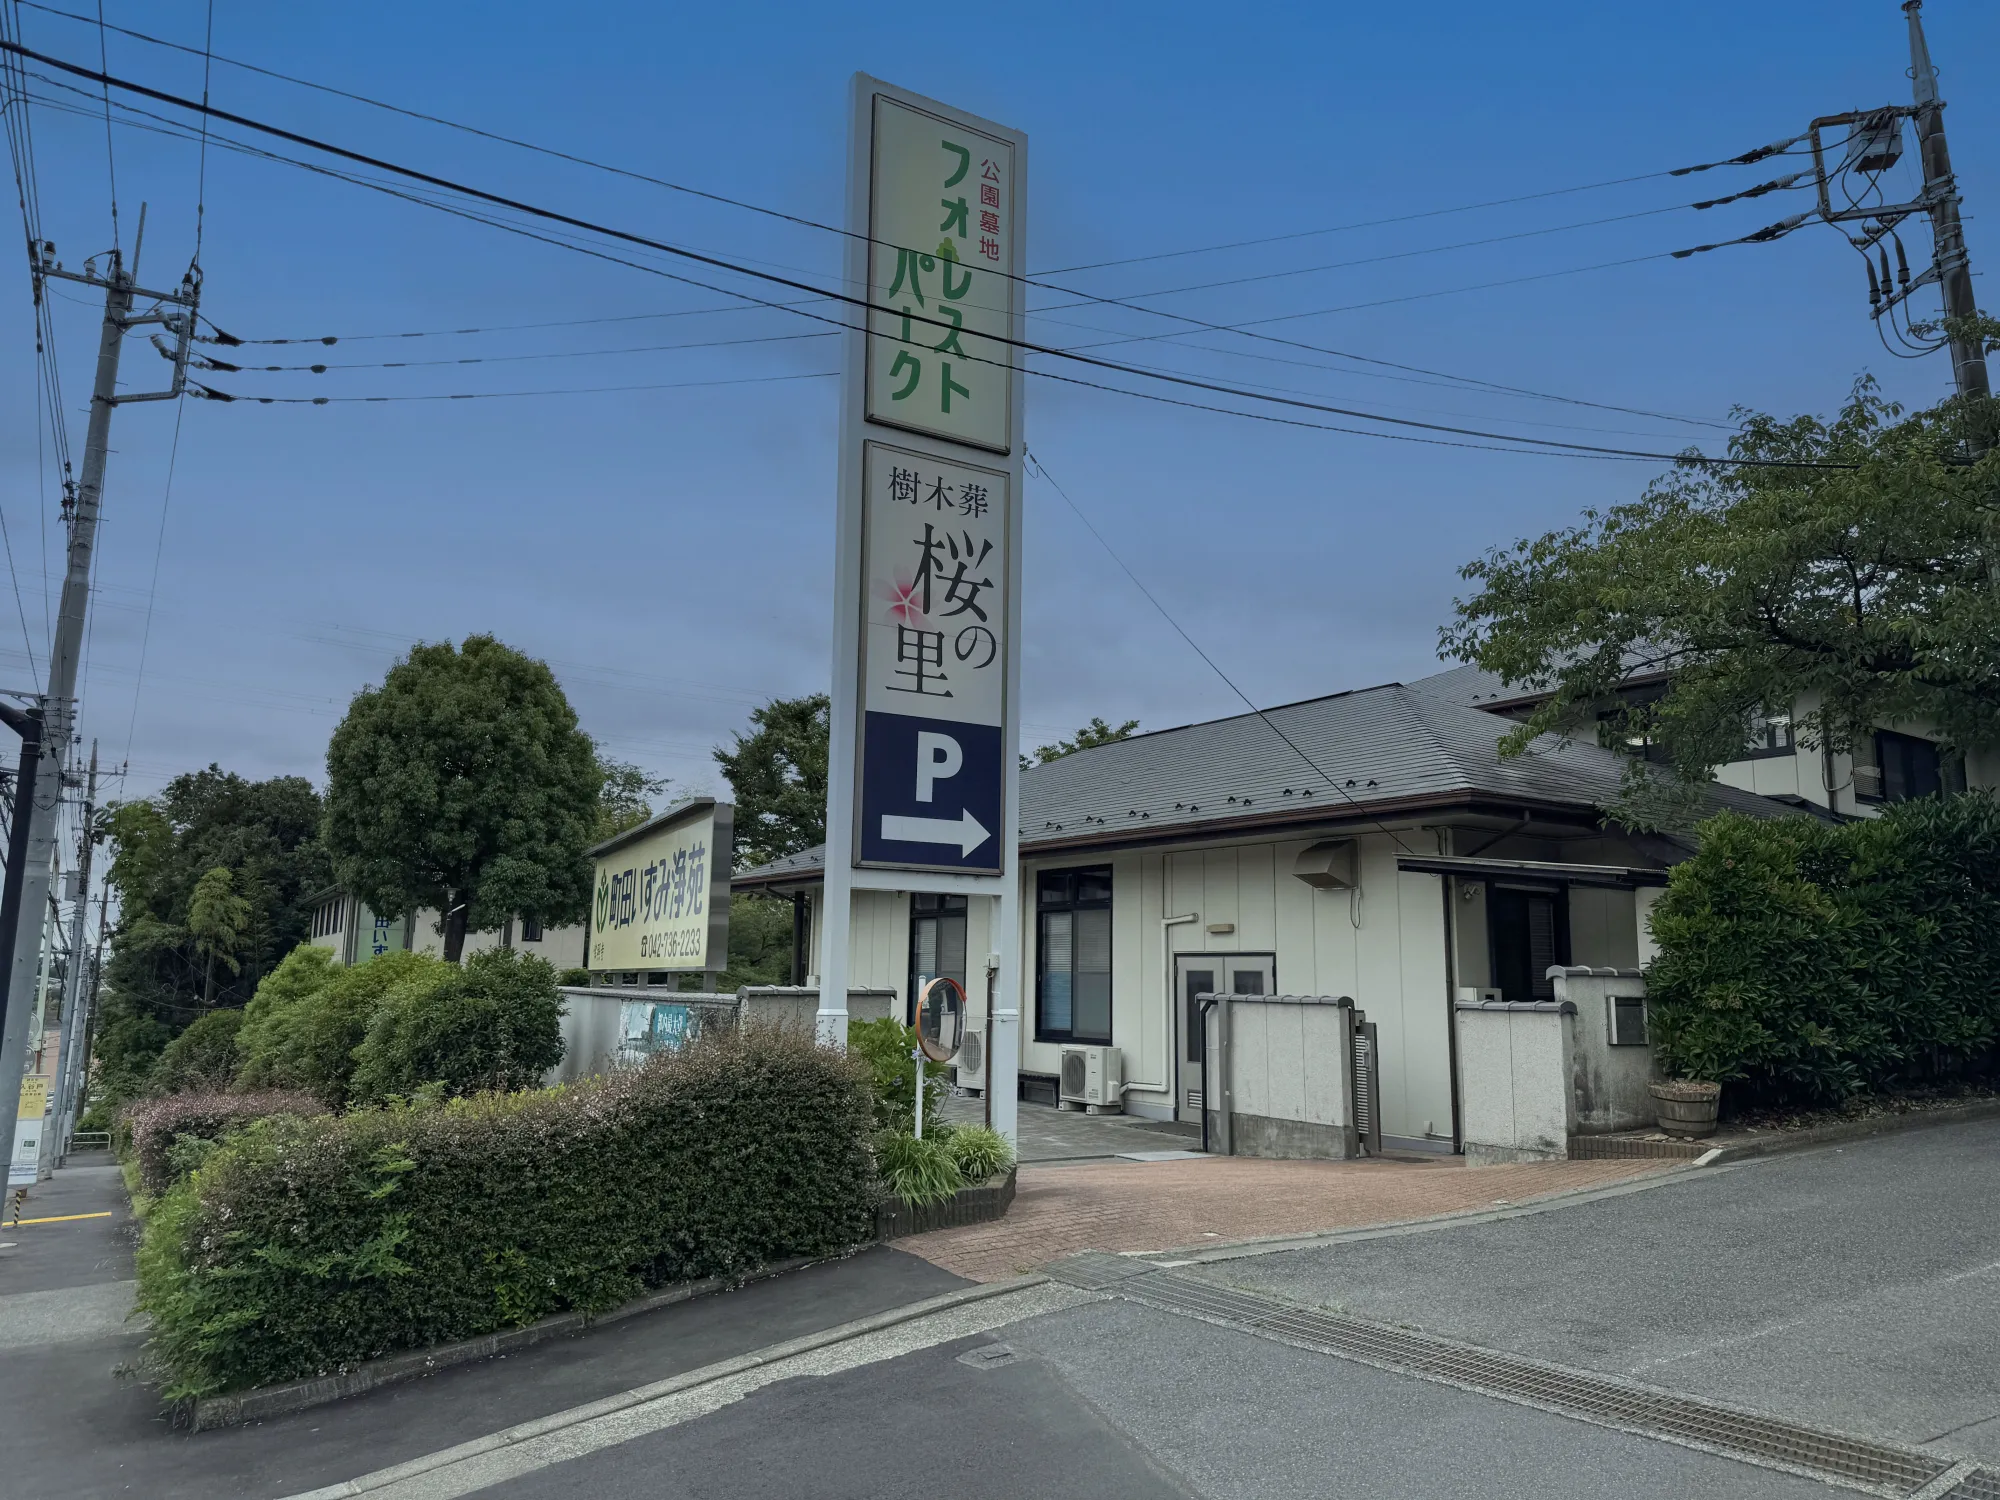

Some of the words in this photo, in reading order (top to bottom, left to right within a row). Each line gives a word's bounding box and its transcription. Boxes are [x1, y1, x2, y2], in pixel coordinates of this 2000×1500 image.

[979, 158, 1000, 262] 公園墓地
[889, 247, 936, 401] パーク
[888, 466, 989, 519] 樹木葬
[915, 731, 963, 803] P
[609, 840, 705, 930] 町田いずみ浄苑
[648, 927, 701, 959] 042-736-2233
